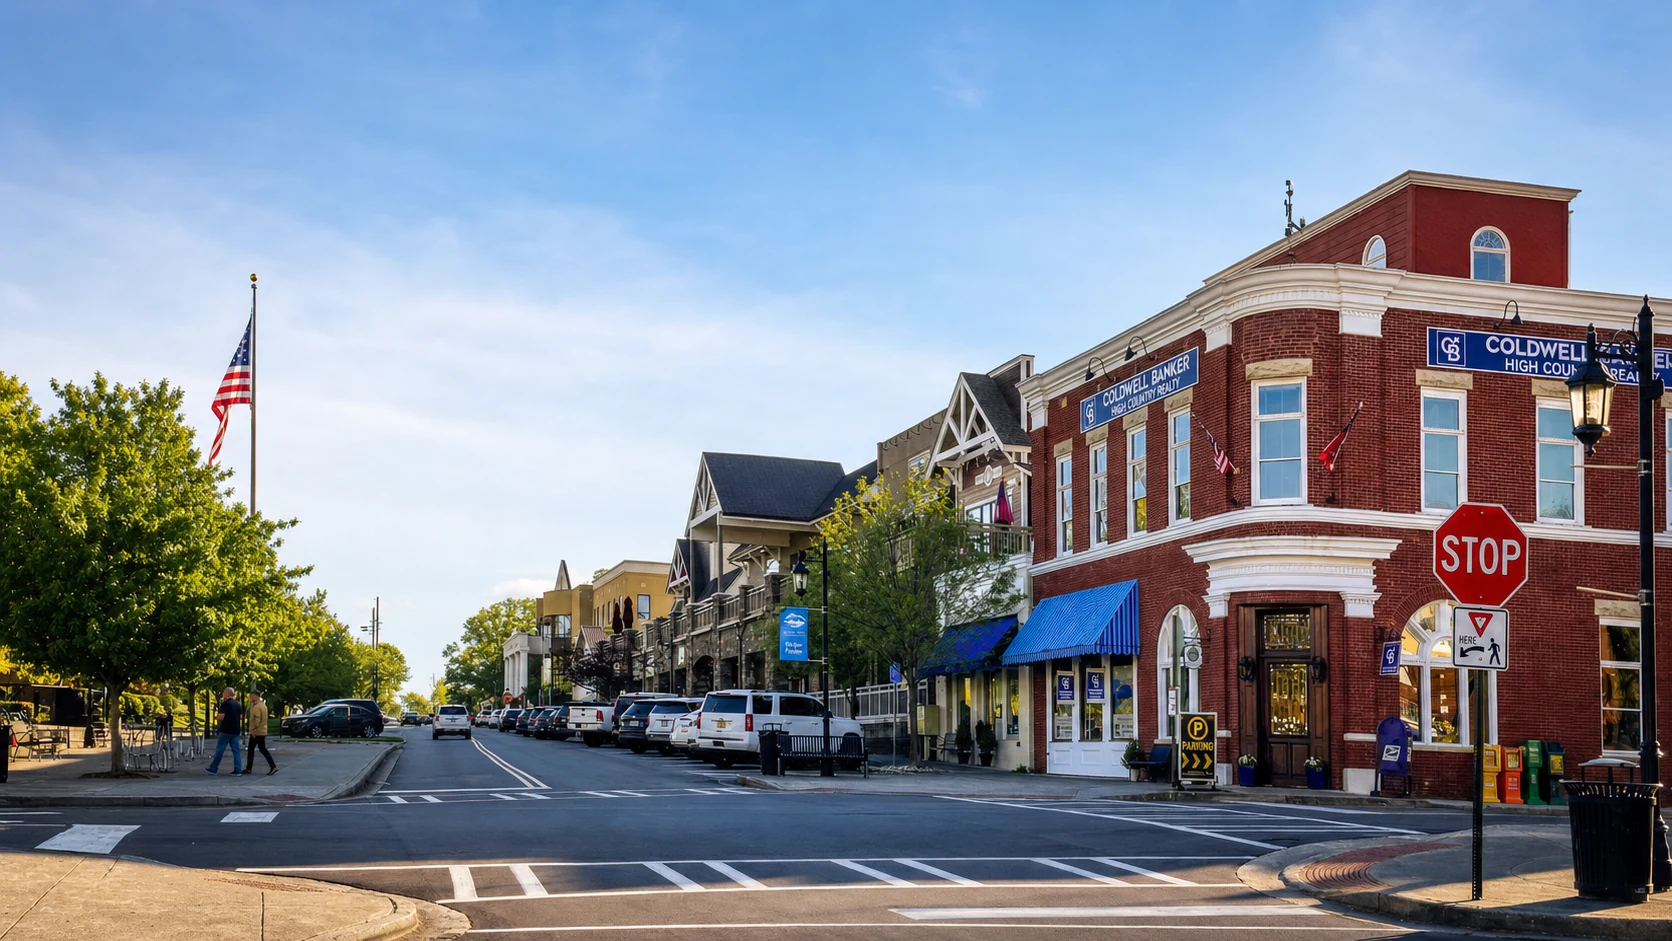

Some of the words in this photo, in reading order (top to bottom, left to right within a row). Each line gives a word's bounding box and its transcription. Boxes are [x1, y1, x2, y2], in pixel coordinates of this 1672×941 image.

[1485, 335, 1588, 362] COLDWELL
[1102, 374, 1149, 406] COLDWELL
[1151, 354, 1190, 385] BANKER
[1505, 358, 1538, 373] HIGH
[1543, 361, 1578, 376] COUN
[1110, 401, 1127, 417] HIGH
[1127, 386, 1157, 409] COUNTRY
[1157, 376, 1180, 397] REALTY
[1441, 535, 1521, 576] STOP
[1458, 635, 1477, 645] HERE
[1193, 721, 1203, 736] P
